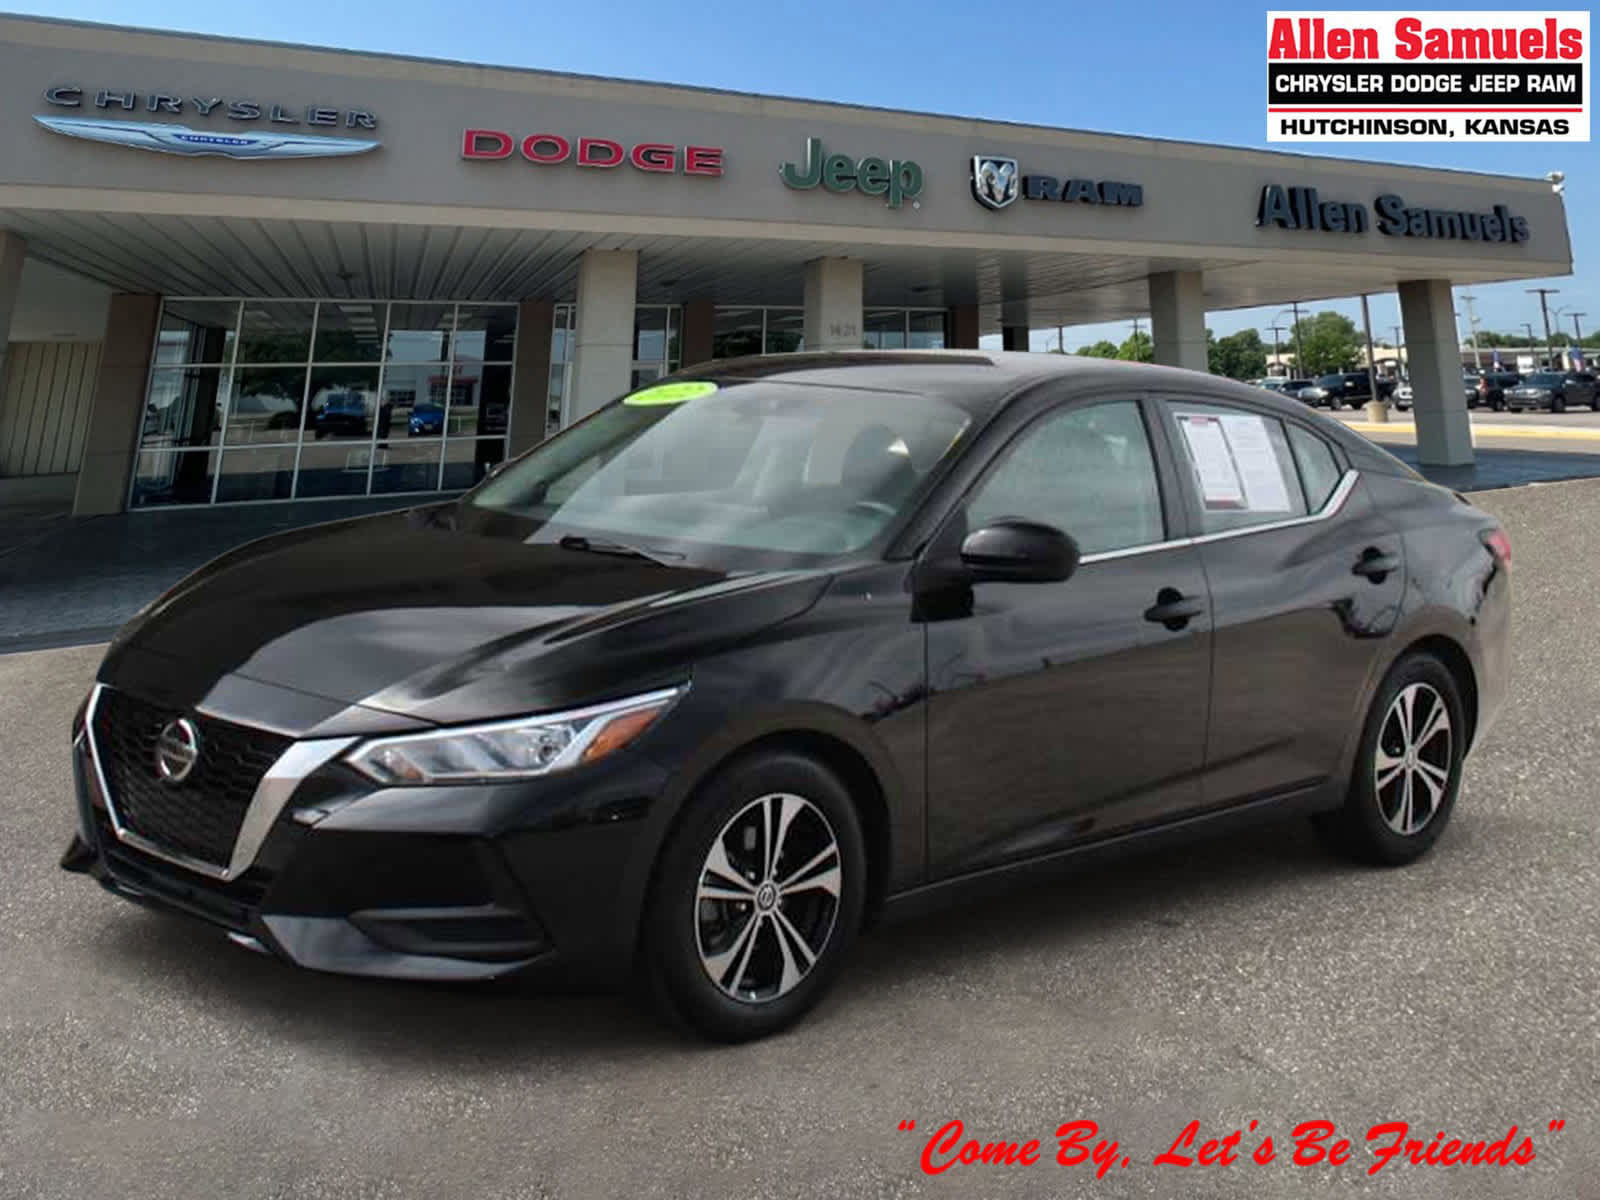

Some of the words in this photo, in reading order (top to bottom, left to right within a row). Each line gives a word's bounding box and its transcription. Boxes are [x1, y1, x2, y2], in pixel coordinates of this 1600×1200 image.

[43, 85, 378, 130] CHRYSLER
[461, 128, 724, 176] DODGE
[779, 137, 925, 209] Jeep
[1022, 174, 1144, 208] RAM
[1256, 183, 1368, 236] Allen
[1376, 193, 1530, 244] Samuels
